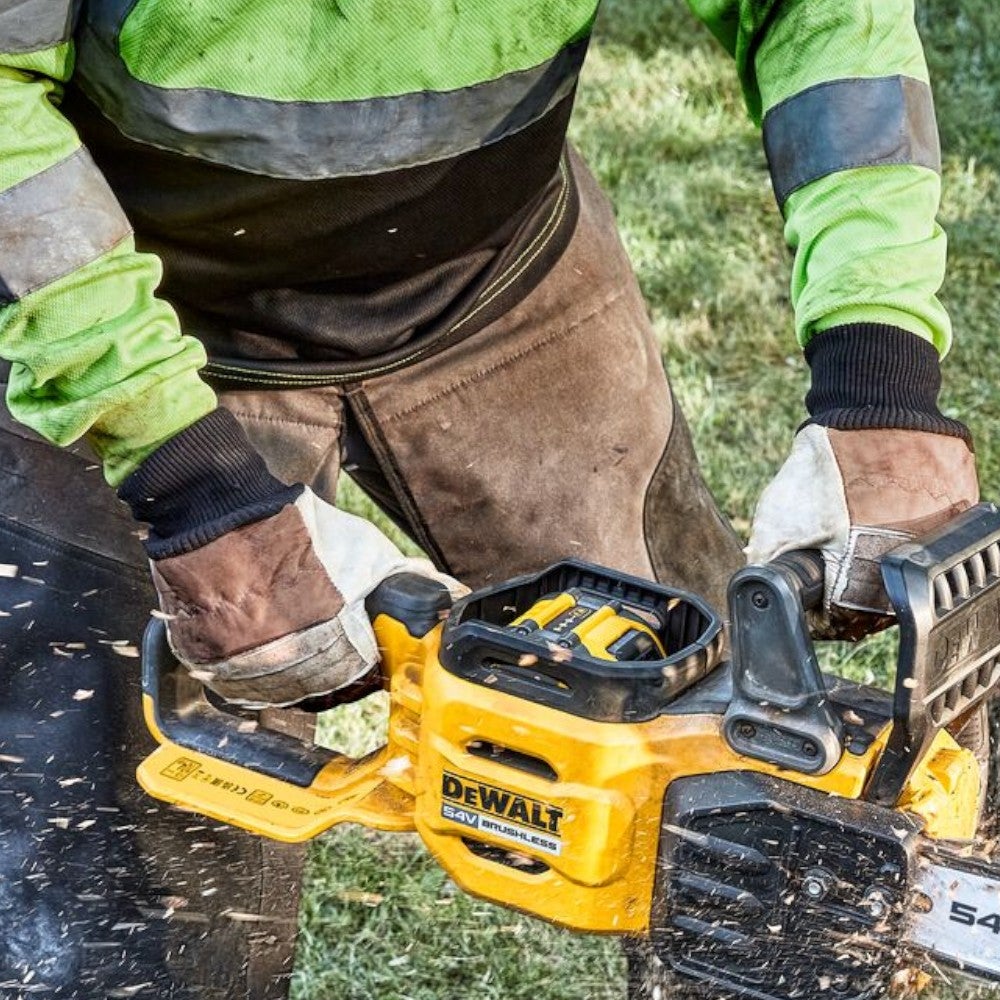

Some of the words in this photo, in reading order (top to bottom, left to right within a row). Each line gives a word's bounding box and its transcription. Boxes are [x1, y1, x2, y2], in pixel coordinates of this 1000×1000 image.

[442, 773, 563, 832] DEWALT
[443, 805, 478, 825] 54V
[481, 819, 558, 851] BRUSHLESS
